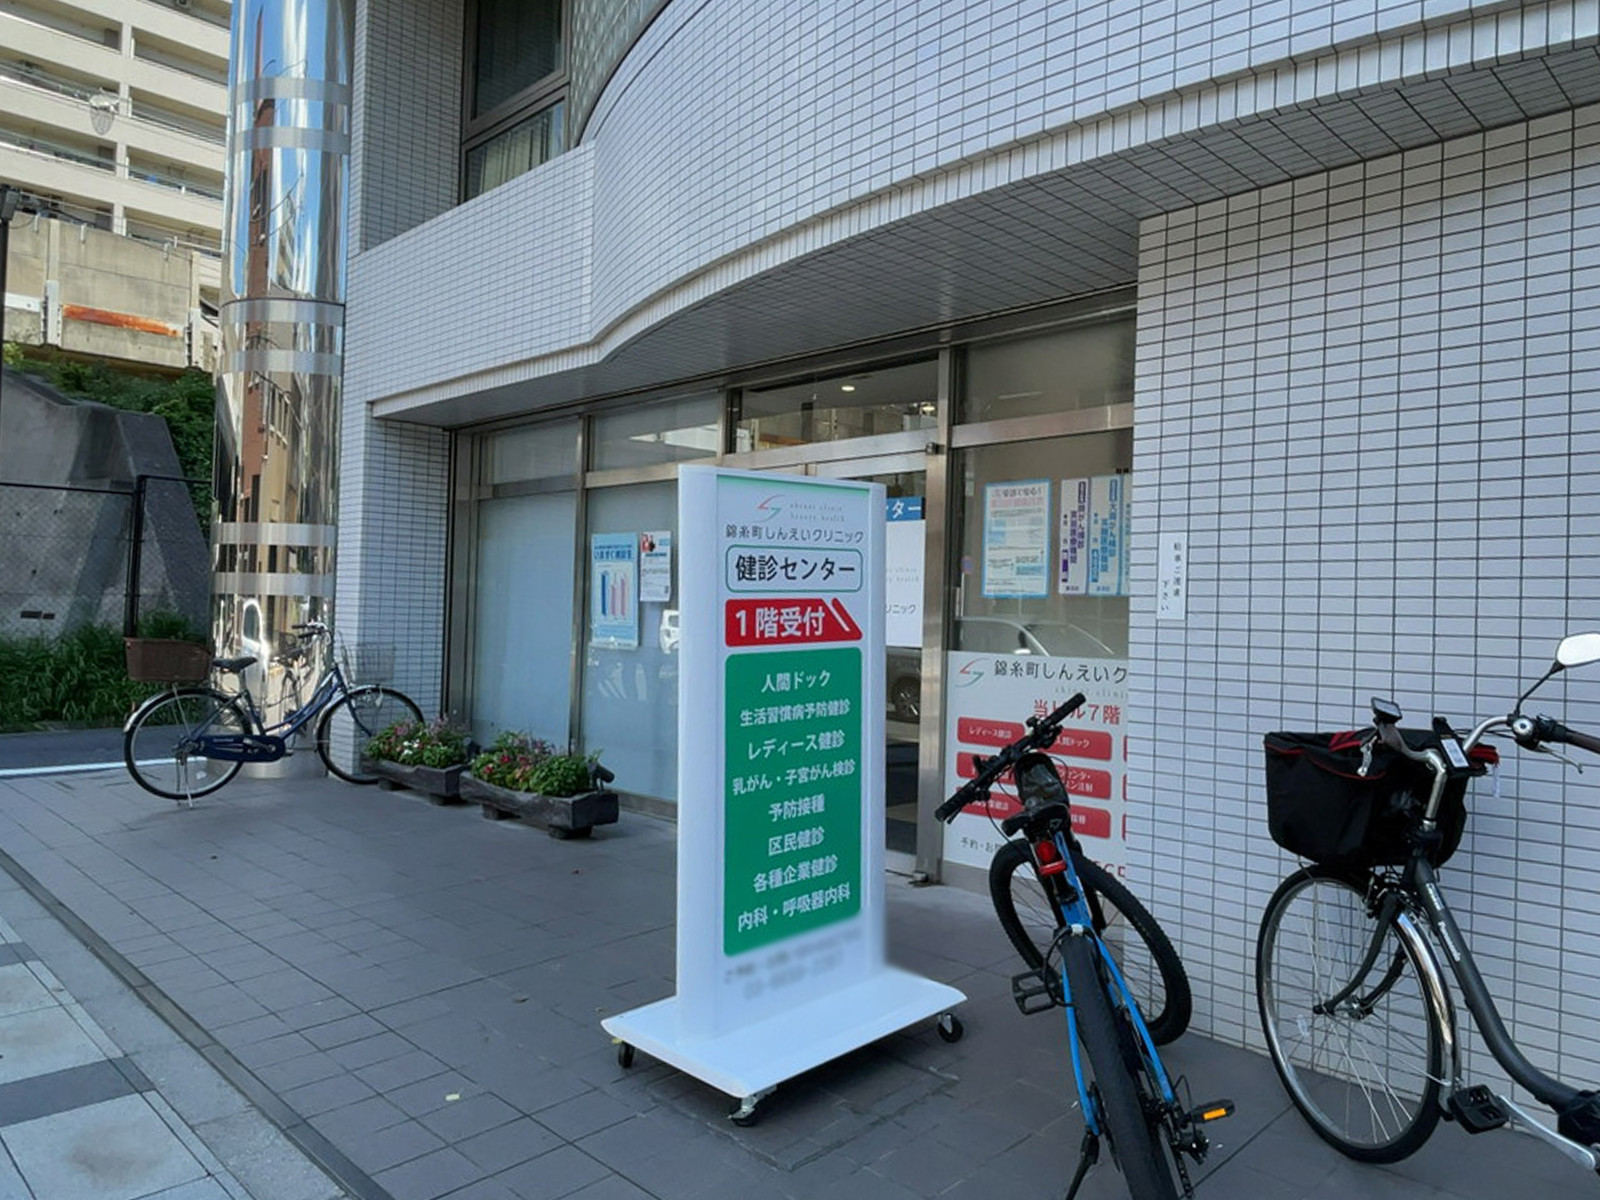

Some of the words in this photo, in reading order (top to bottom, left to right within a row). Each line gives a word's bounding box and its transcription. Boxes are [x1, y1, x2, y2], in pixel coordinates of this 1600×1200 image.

[886, 500, 921, 518] ター
[725, 523, 865, 545] 錦糸町しんえいクリニック
[735, 554, 856, 582] 健診センター
[735, 606, 826, 638] 1階受付
[761, 670, 831, 693] 人間ドック
[993, 659, 1128, 685] 錦糸町しんえいク
[739, 698, 851, 727] 生活習慣病予防健診
[747, 730, 846, 760] レディース健診
[732, 758, 856, 796] 乳がん・子宮がん検診
[768, 793, 825, 822] 予防接種
[768, 826, 825, 856] 区民健診
[753, 854, 838, 893] 各種企業健診
[737, 882, 851, 933] 内科・呼吸器内科
